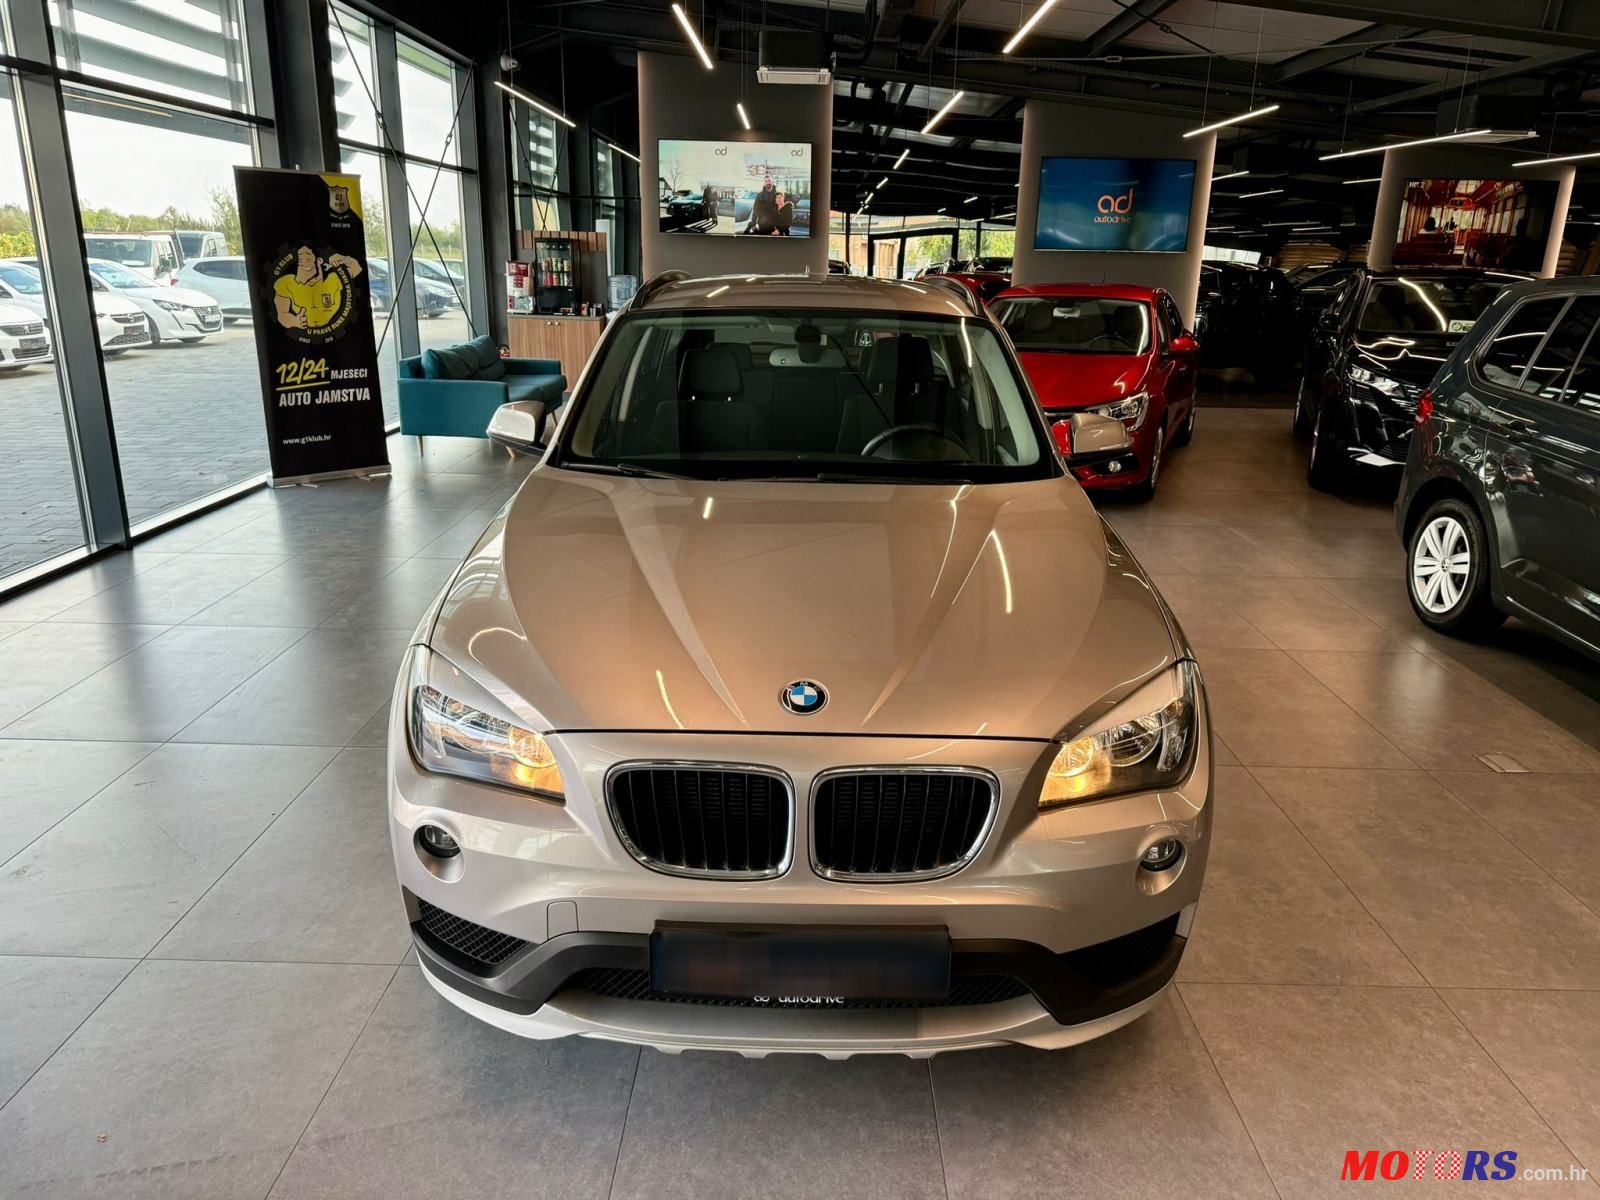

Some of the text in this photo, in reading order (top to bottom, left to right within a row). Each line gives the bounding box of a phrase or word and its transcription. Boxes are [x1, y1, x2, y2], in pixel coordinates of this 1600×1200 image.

[1097, 188, 1134, 214] ad
[276, 357, 368, 385] 12/24 MJESECI
[279, 387, 371, 407] AUTO JAMSTVA
